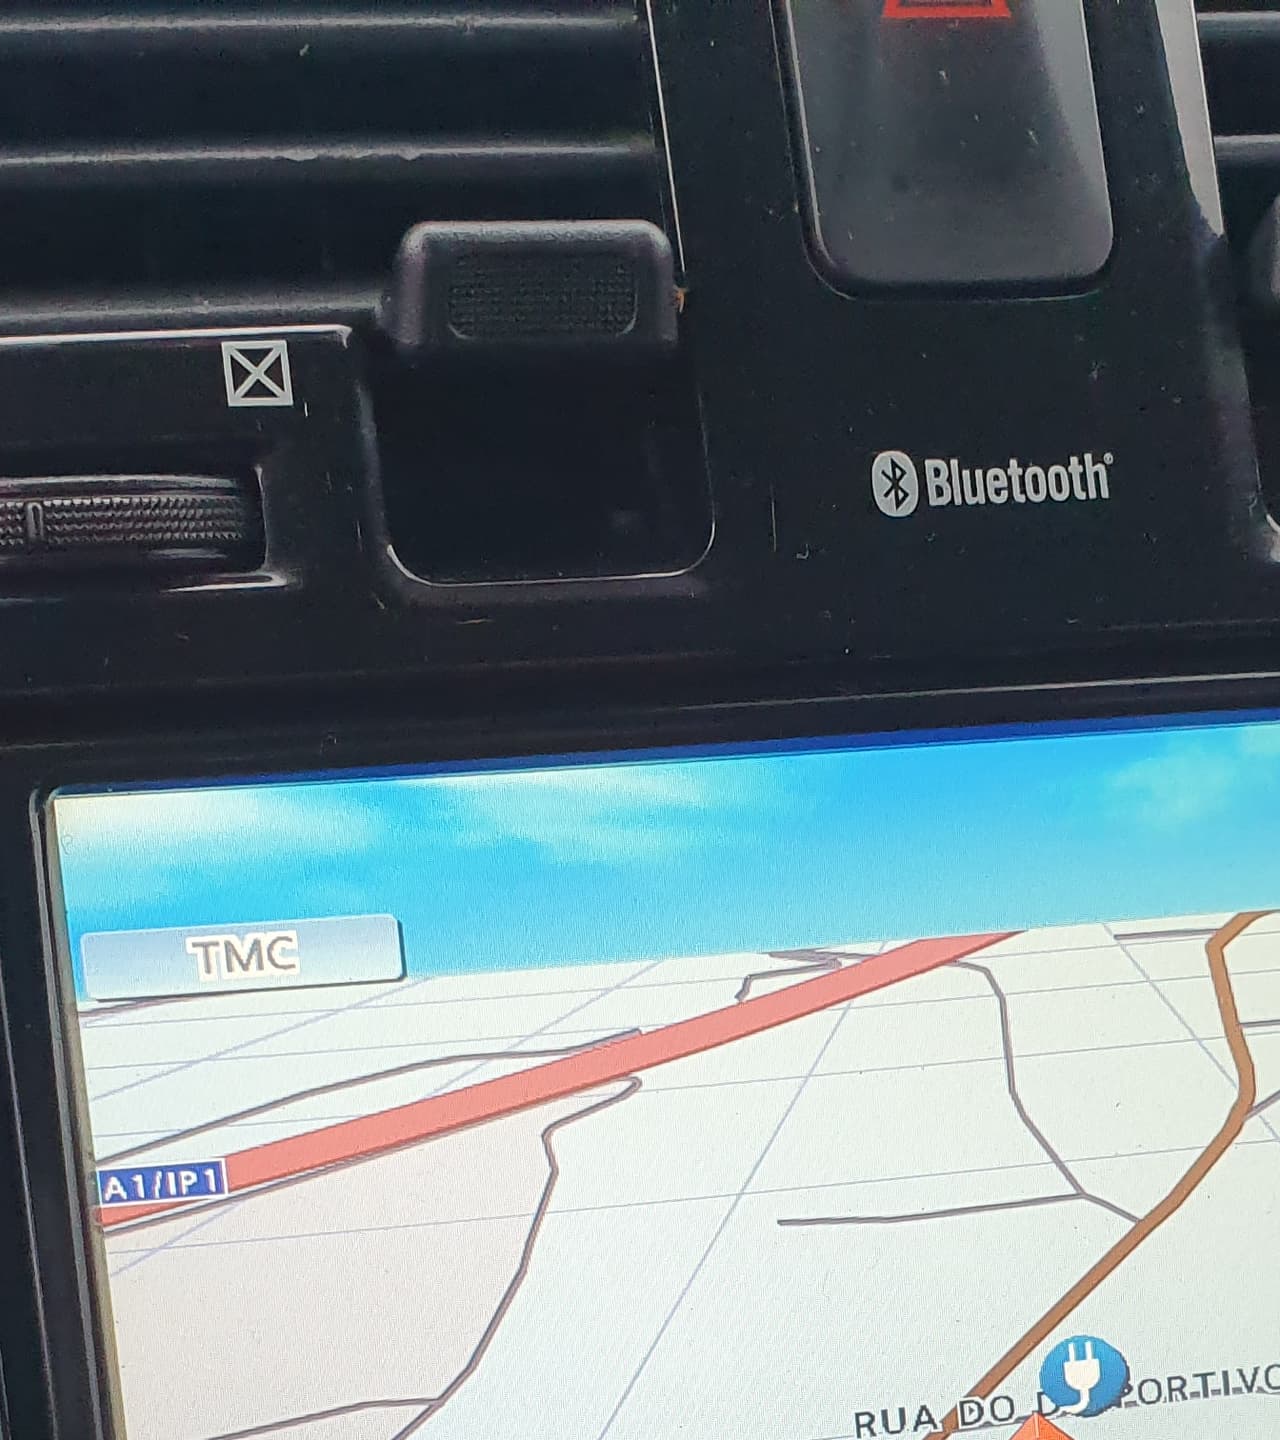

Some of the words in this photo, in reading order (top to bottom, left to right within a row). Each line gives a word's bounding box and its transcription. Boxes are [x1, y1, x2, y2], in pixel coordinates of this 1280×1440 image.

[190, 935, 297, 975] TMC
[853, 1404, 938, 1440] RUA
[959, 1395, 1016, 1427] DO
